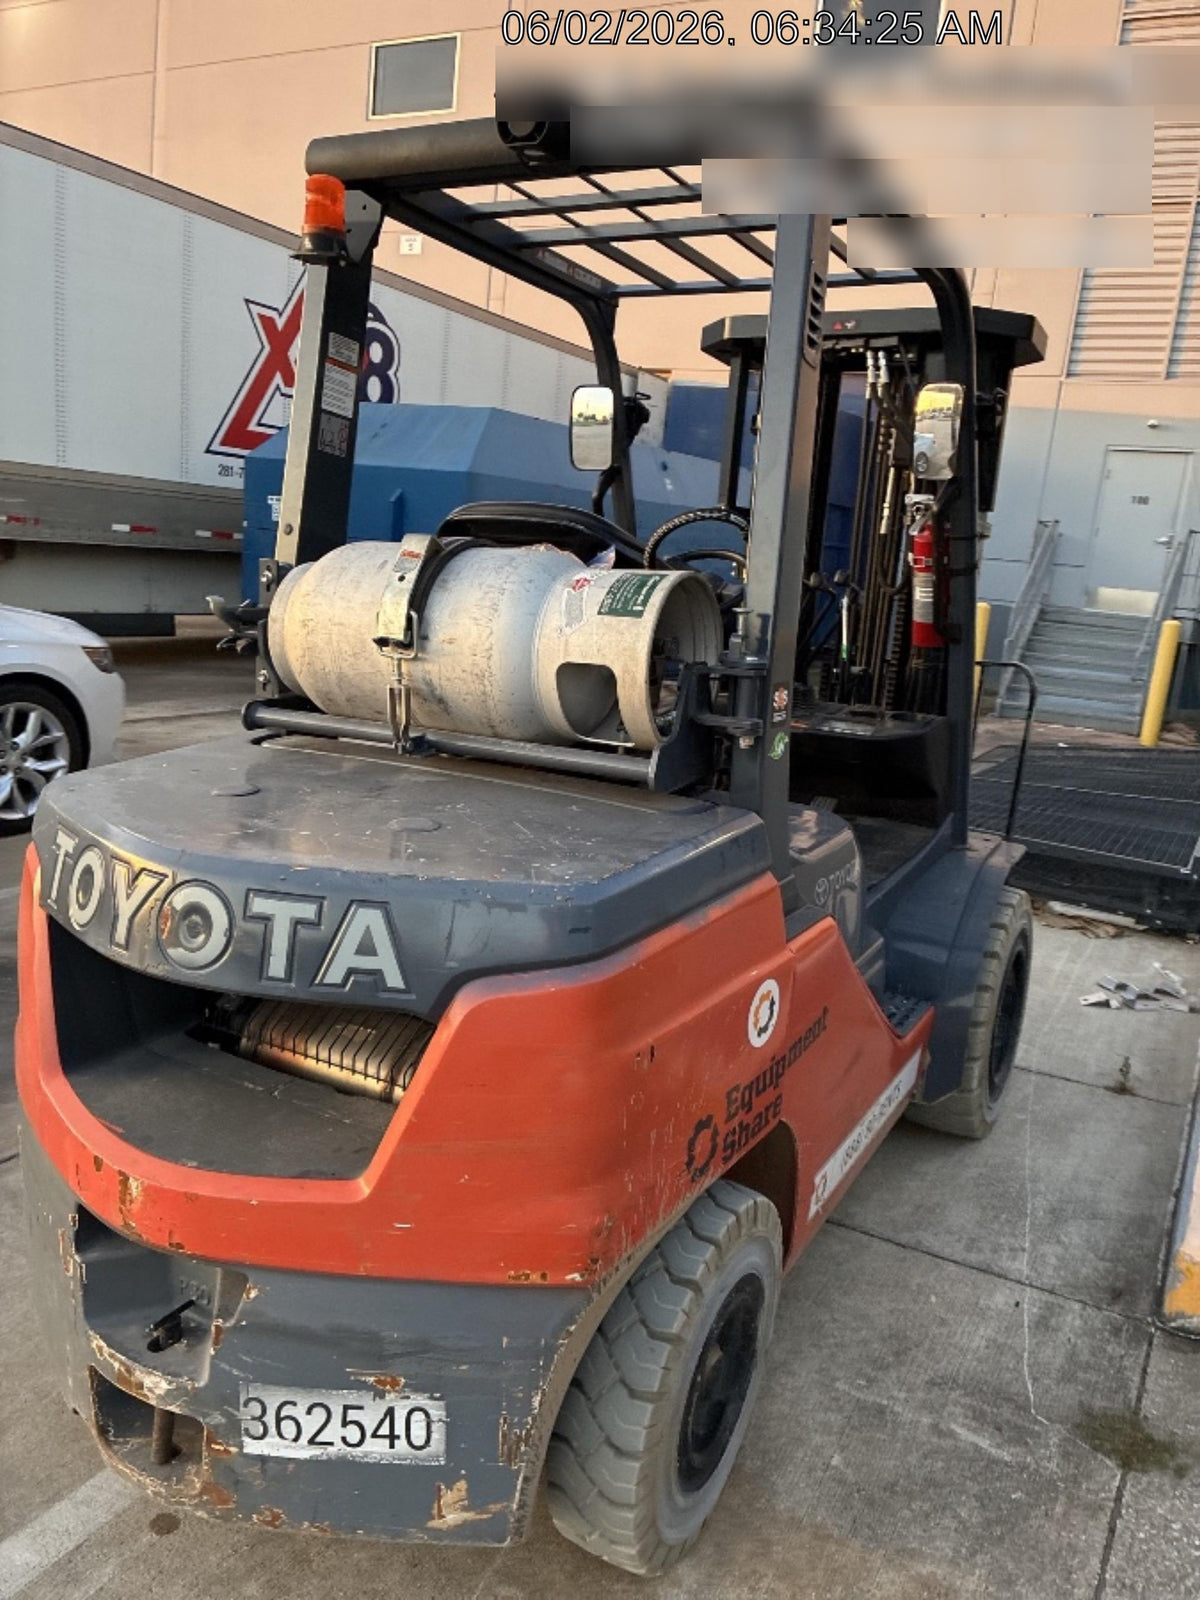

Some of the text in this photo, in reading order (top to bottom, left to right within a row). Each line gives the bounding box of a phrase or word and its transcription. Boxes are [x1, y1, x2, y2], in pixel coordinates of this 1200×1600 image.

[46, 823, 413, 996] TOYOTA
[724, 1005, 830, 1124] Equipment
[720, 1092, 783, 1165] Share
[242, 1396, 433, 1451] 362540
